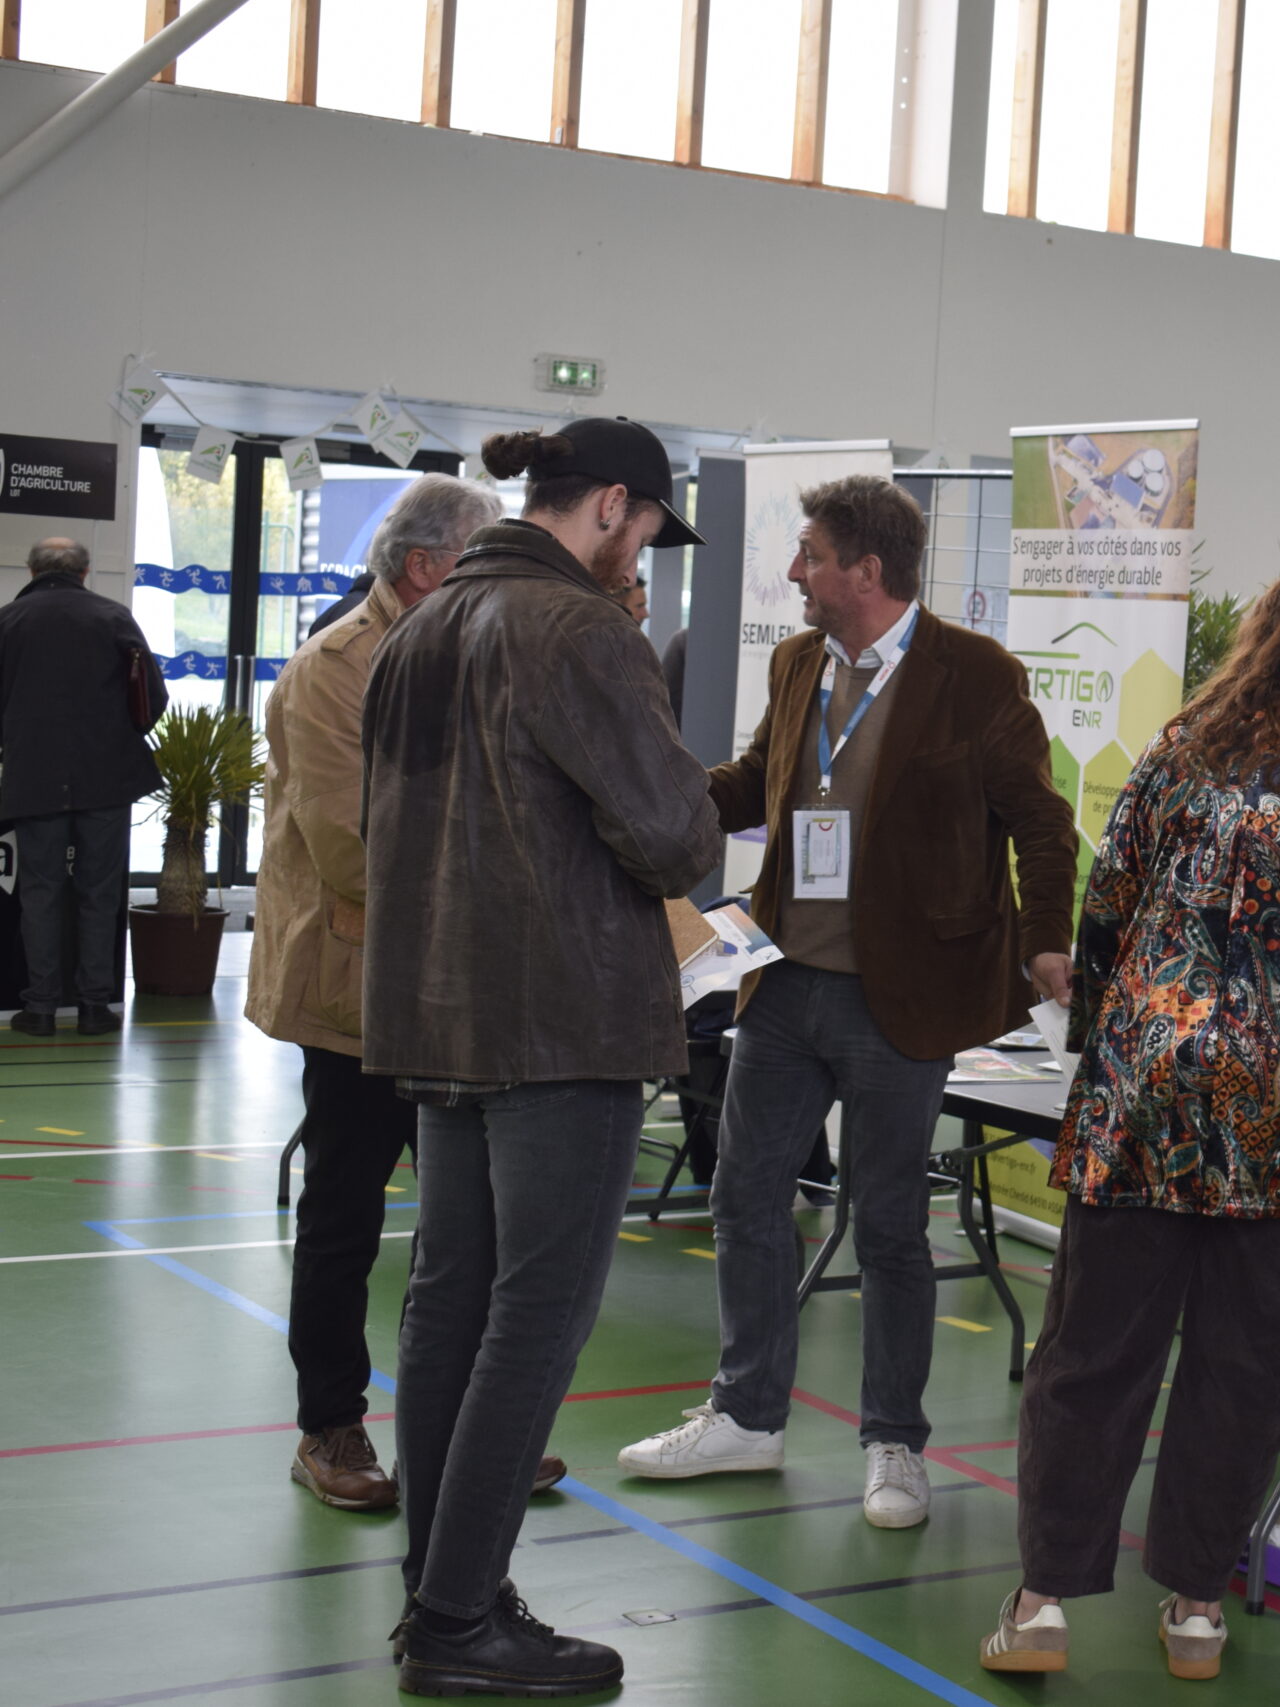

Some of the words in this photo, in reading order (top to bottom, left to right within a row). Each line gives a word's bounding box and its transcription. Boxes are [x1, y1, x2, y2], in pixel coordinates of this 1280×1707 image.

[11, 463, 64, 478] CHAMBRE
[10, 476, 91, 493] D'AGRICULTURE
[1013, 536, 1064, 561] S'engager
[1066, 535, 1074, 556] à
[1077, 540, 1095, 555] vos
[1097, 535, 1128, 556] côtés
[1130, 536, 1157, 556] dans
[1160, 540, 1182, 557] vos
[1022, 565, 1063, 587] projets
[1065, 564, 1116, 590] d'énergie
[1117, 565, 1162, 586] durable
[1072, 709, 1102, 728] ENR
